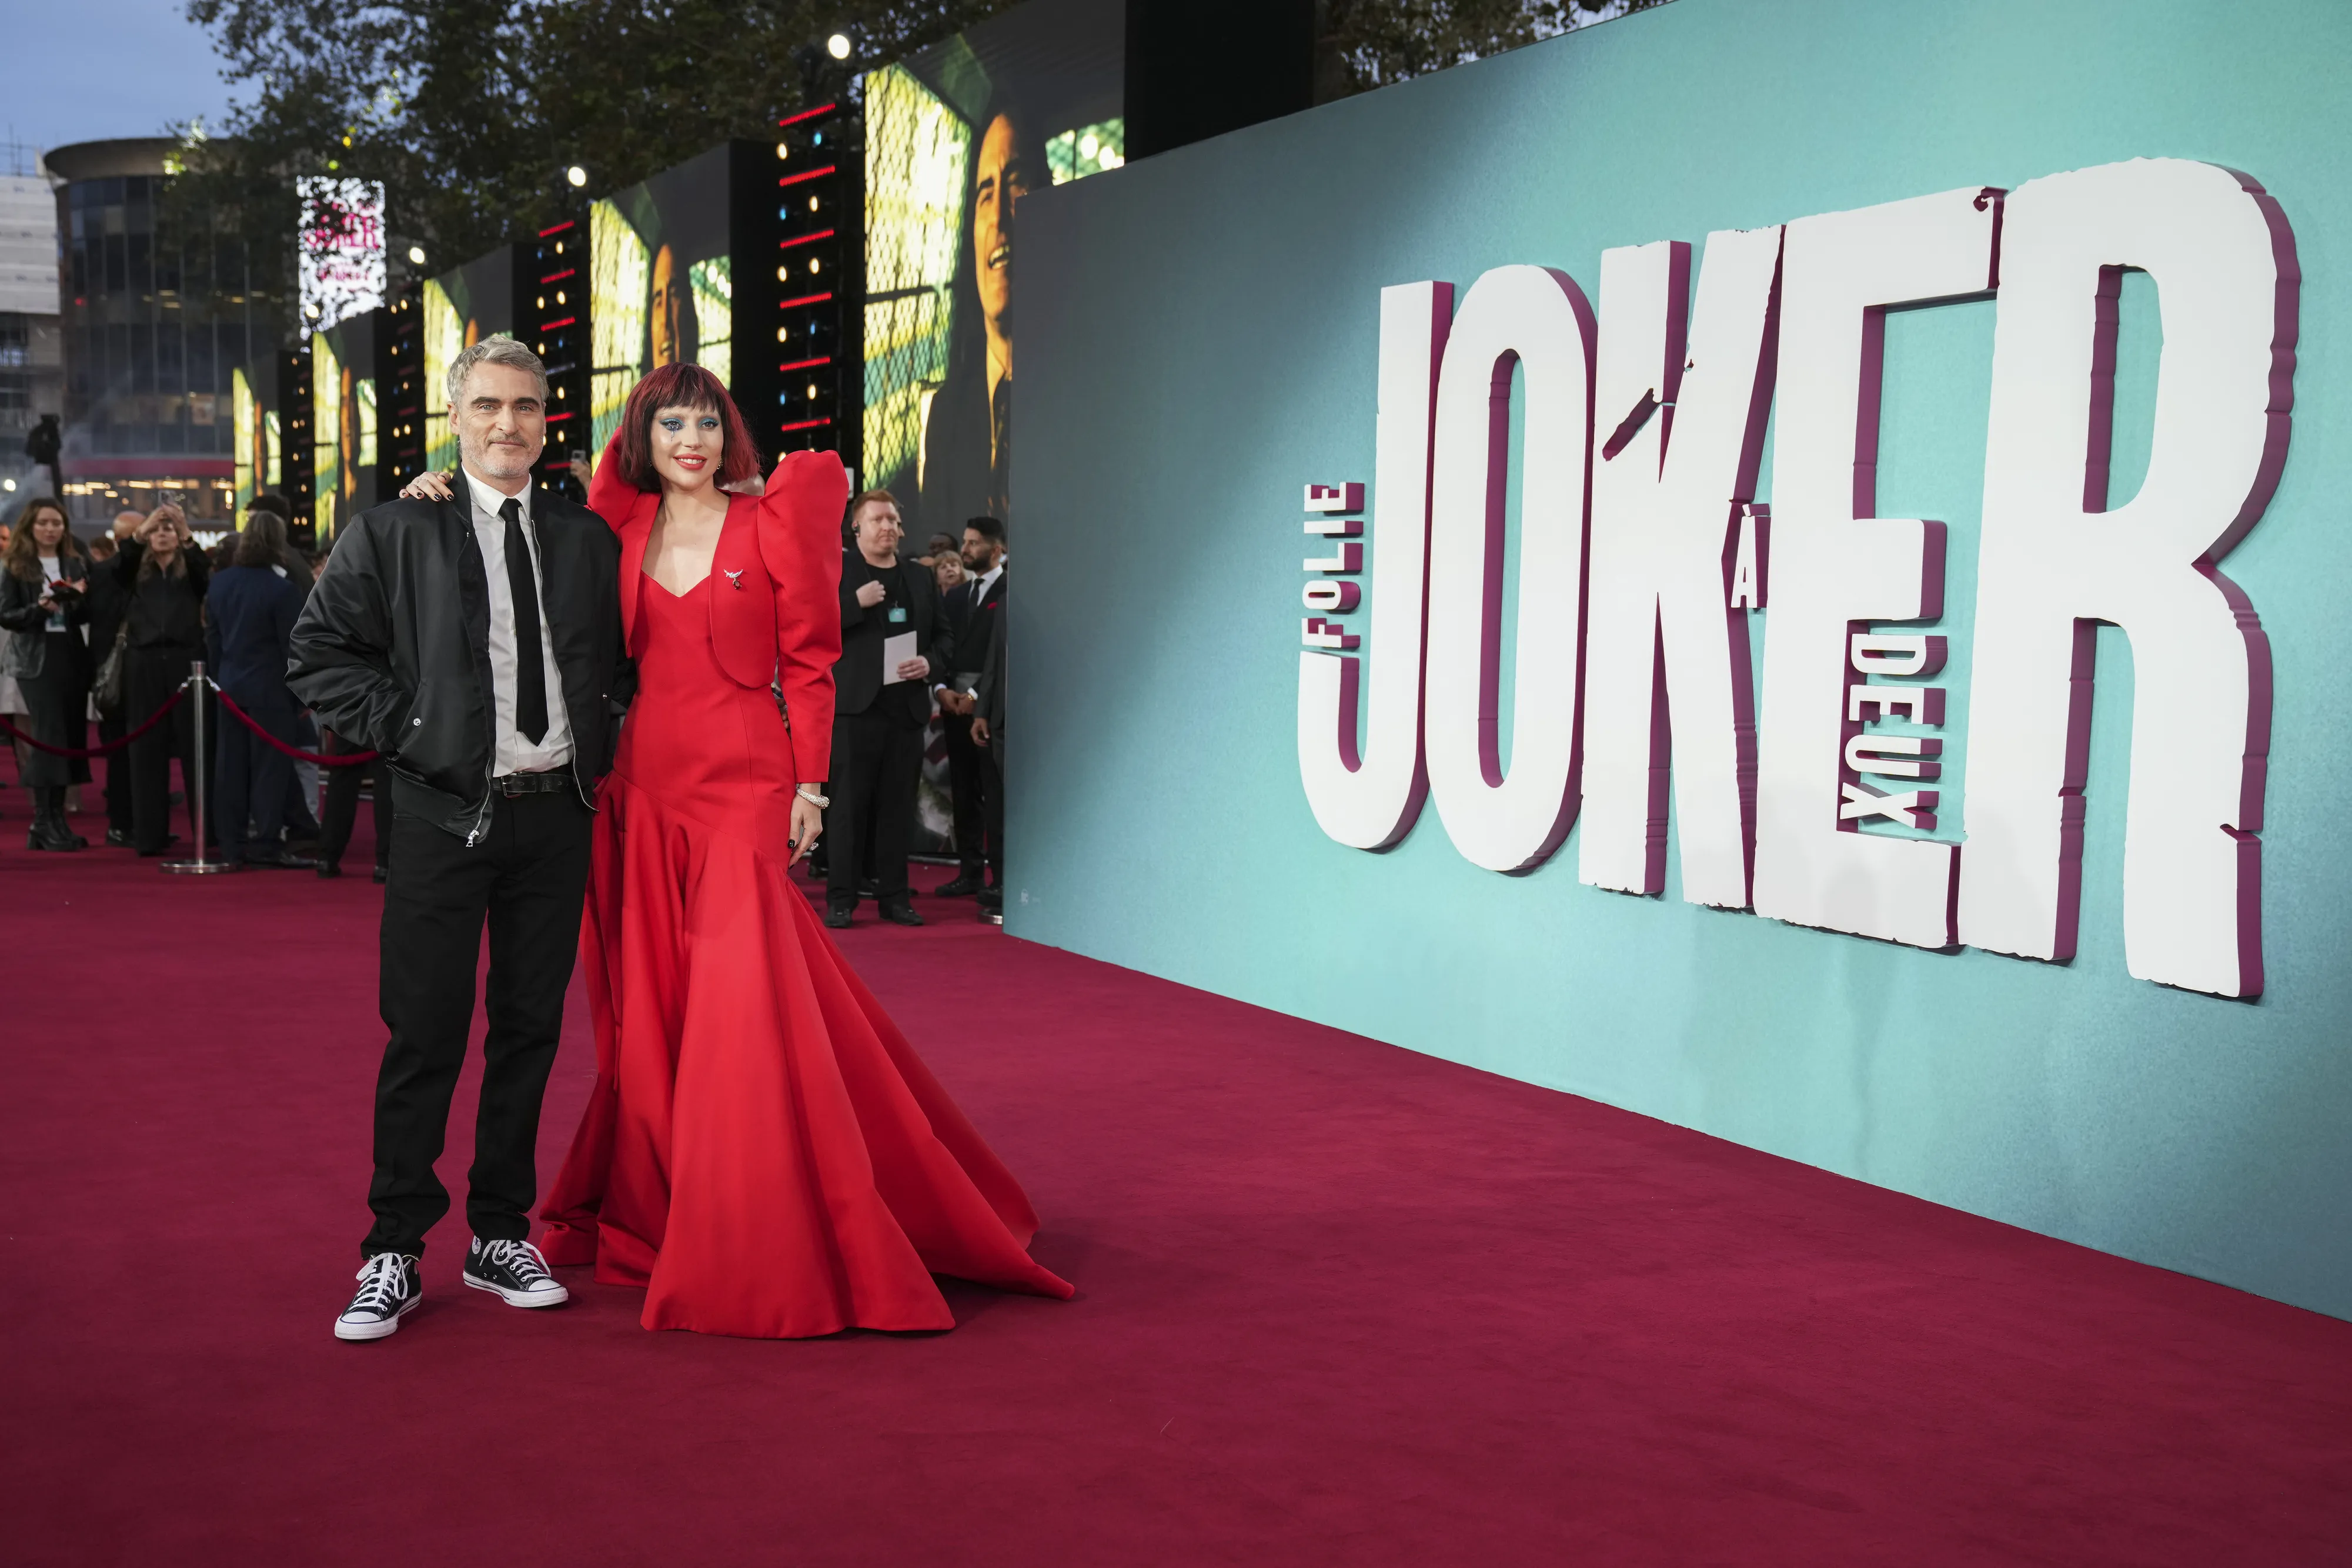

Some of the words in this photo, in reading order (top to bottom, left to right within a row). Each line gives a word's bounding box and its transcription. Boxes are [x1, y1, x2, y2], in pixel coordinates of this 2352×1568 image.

[1297, 156, 2296, 1004] JOKER
[1301, 482, 1356, 648] FOLIE
[1730, 504, 1764, 608] À
[1840, 633, 1938, 829] DEUX
